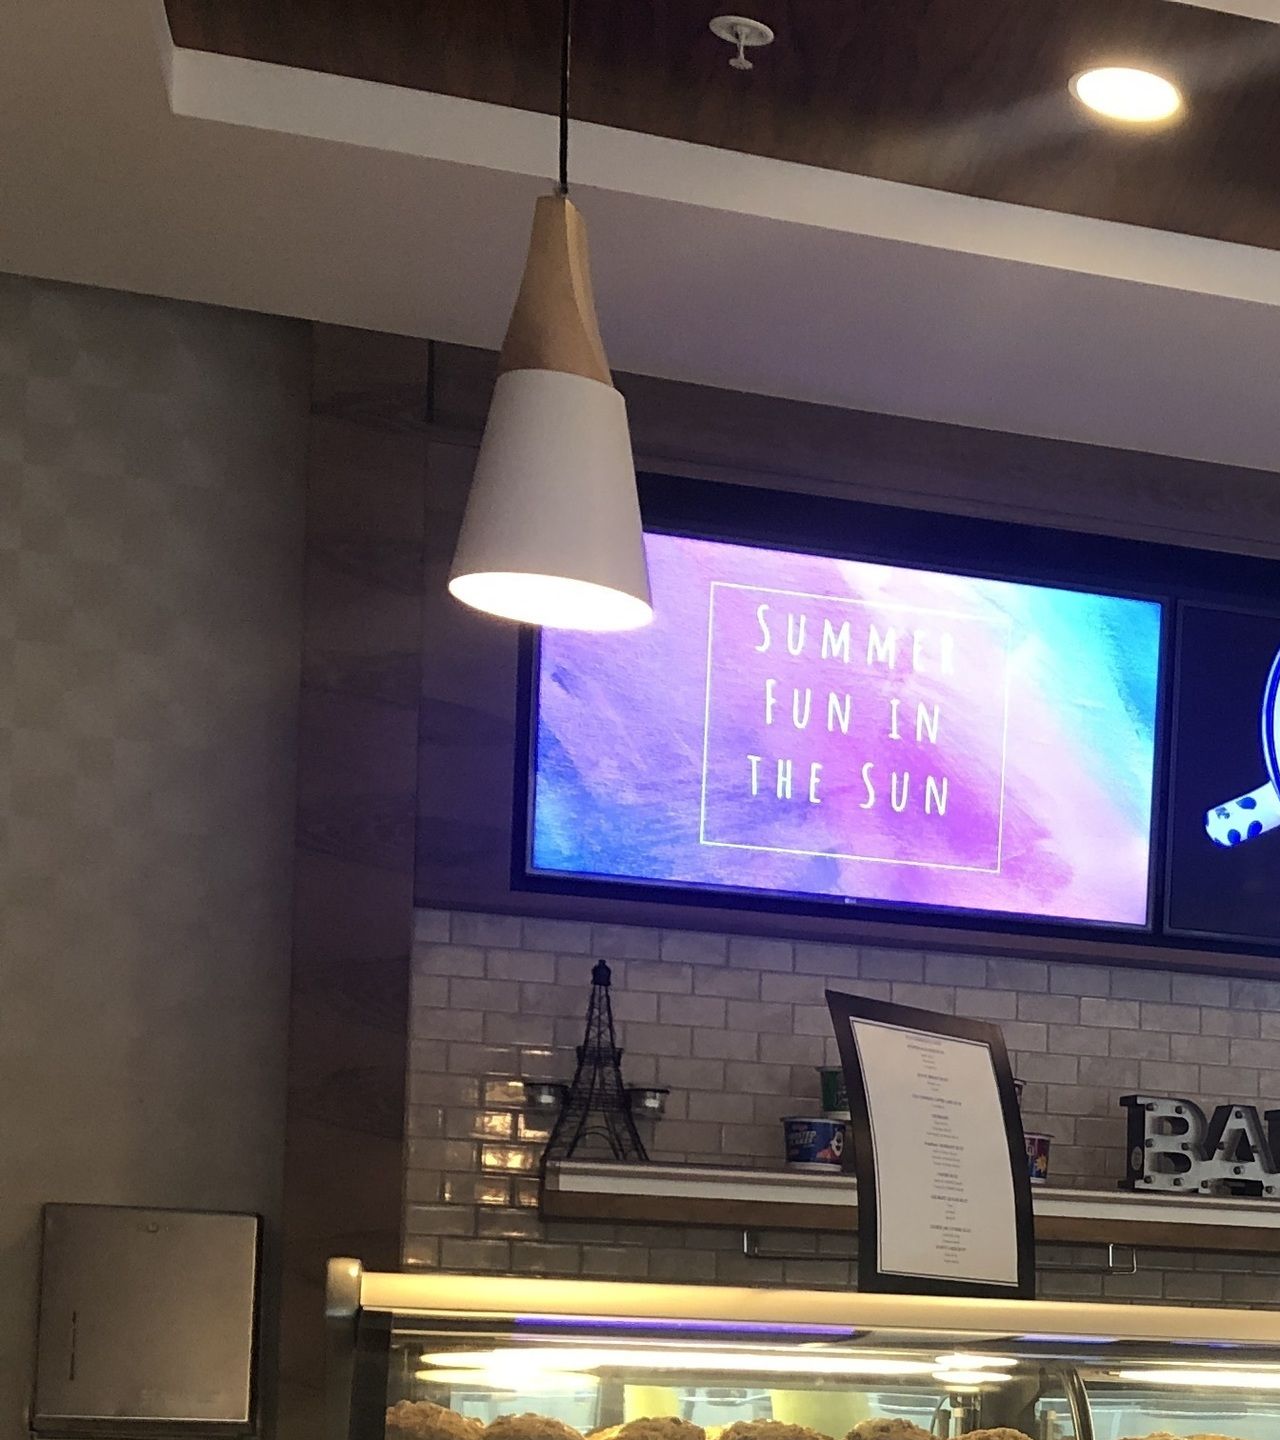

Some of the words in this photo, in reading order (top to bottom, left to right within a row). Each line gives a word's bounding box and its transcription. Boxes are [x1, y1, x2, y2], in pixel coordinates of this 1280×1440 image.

[766, 678, 851, 735] FUN
[888, 698, 940, 744] IN
[747, 754, 823, 804] THE
[859, 762, 948, 816] SUN
